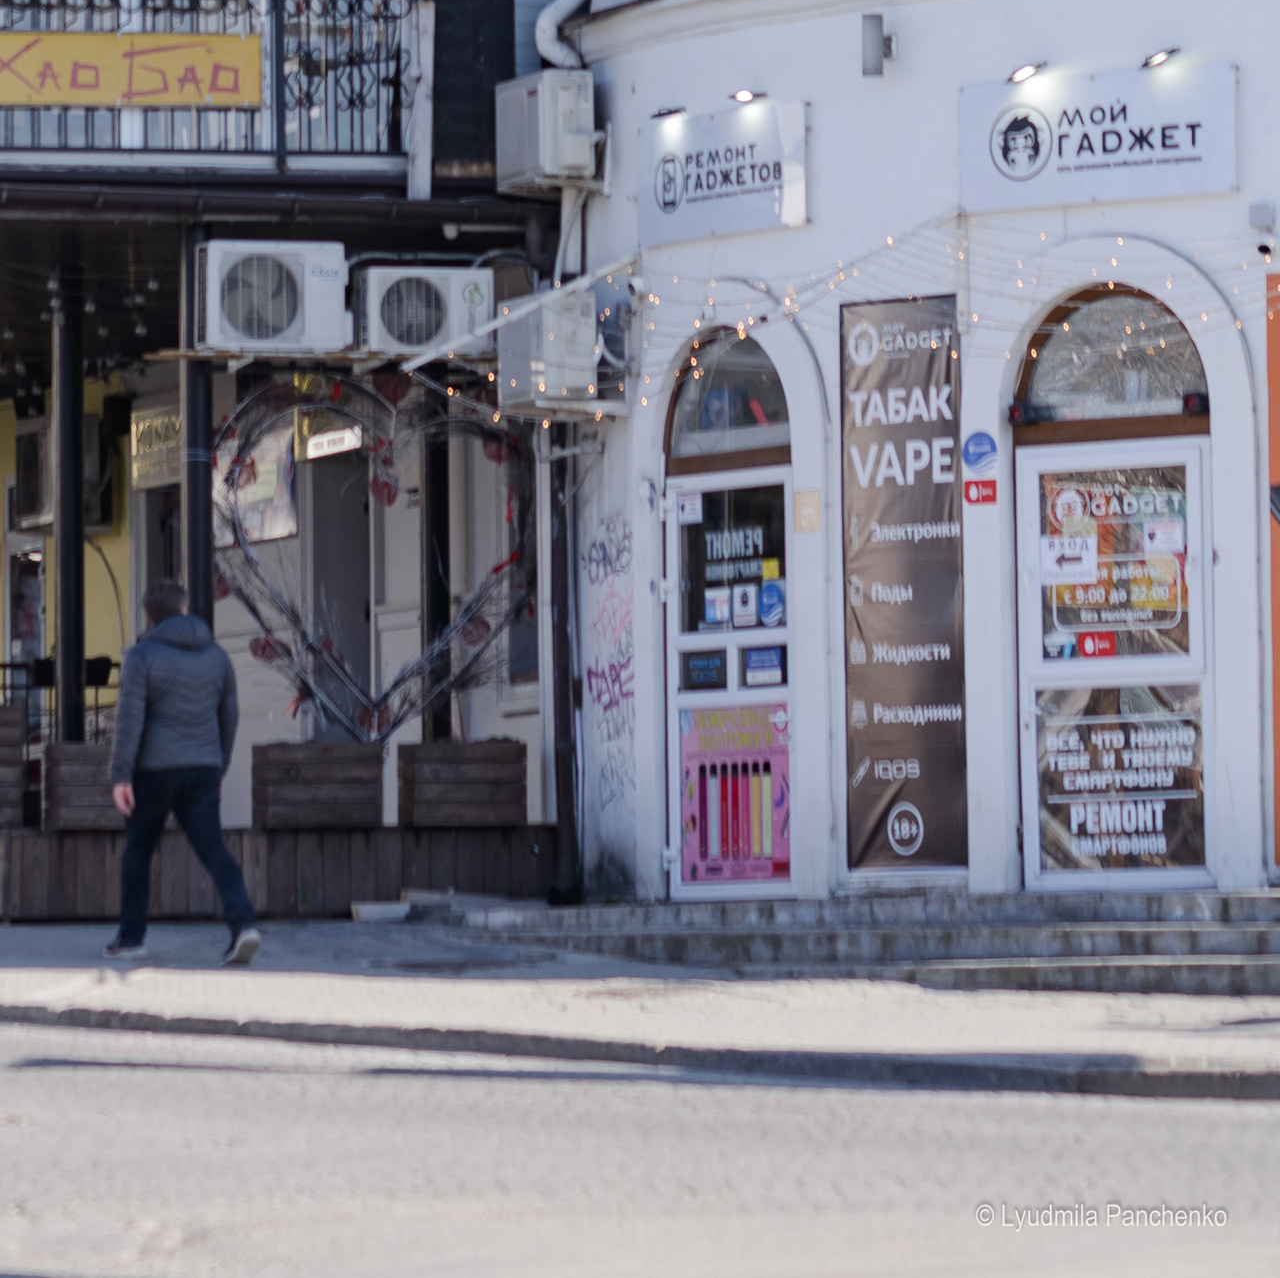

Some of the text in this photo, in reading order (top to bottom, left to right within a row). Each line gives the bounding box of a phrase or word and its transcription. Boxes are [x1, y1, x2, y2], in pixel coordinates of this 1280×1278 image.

[1058, 98, 1127, 128] МОЙ
[685, 144, 757, 170] РЕМОНТ
[882, 328, 953, 352] GADGET
[849, 383, 953, 427] ТАБАК
[850, 437, 955, 488] VAPE
[1091, 494, 1183, 517] GADGET
[870, 521, 961, 542] Электронки
[871, 582, 913, 605] Поды
[1075, 587, 1106, 604] 9:00
[1109, 587, 1127, 605] до
[1131, 585, 1170, 602] 22:00
[872, 643, 951, 666] Жидкости
[873, 703, 962, 727] Расходники
[1091, 729, 1125, 750] ЧТО
[1130, 727, 1196, 748] НУЖНО
[1048, 748, 1193, 772] ТЕБЕ И ТВОЕМУ
[1063, 768, 1174, 791] СМАРТФОНУ
[892, 818, 918, 841] 18+
[1071, 800, 1166, 835] РЕМОНТ
[1072, 833, 1167, 857] СМАРТФОНОВ
